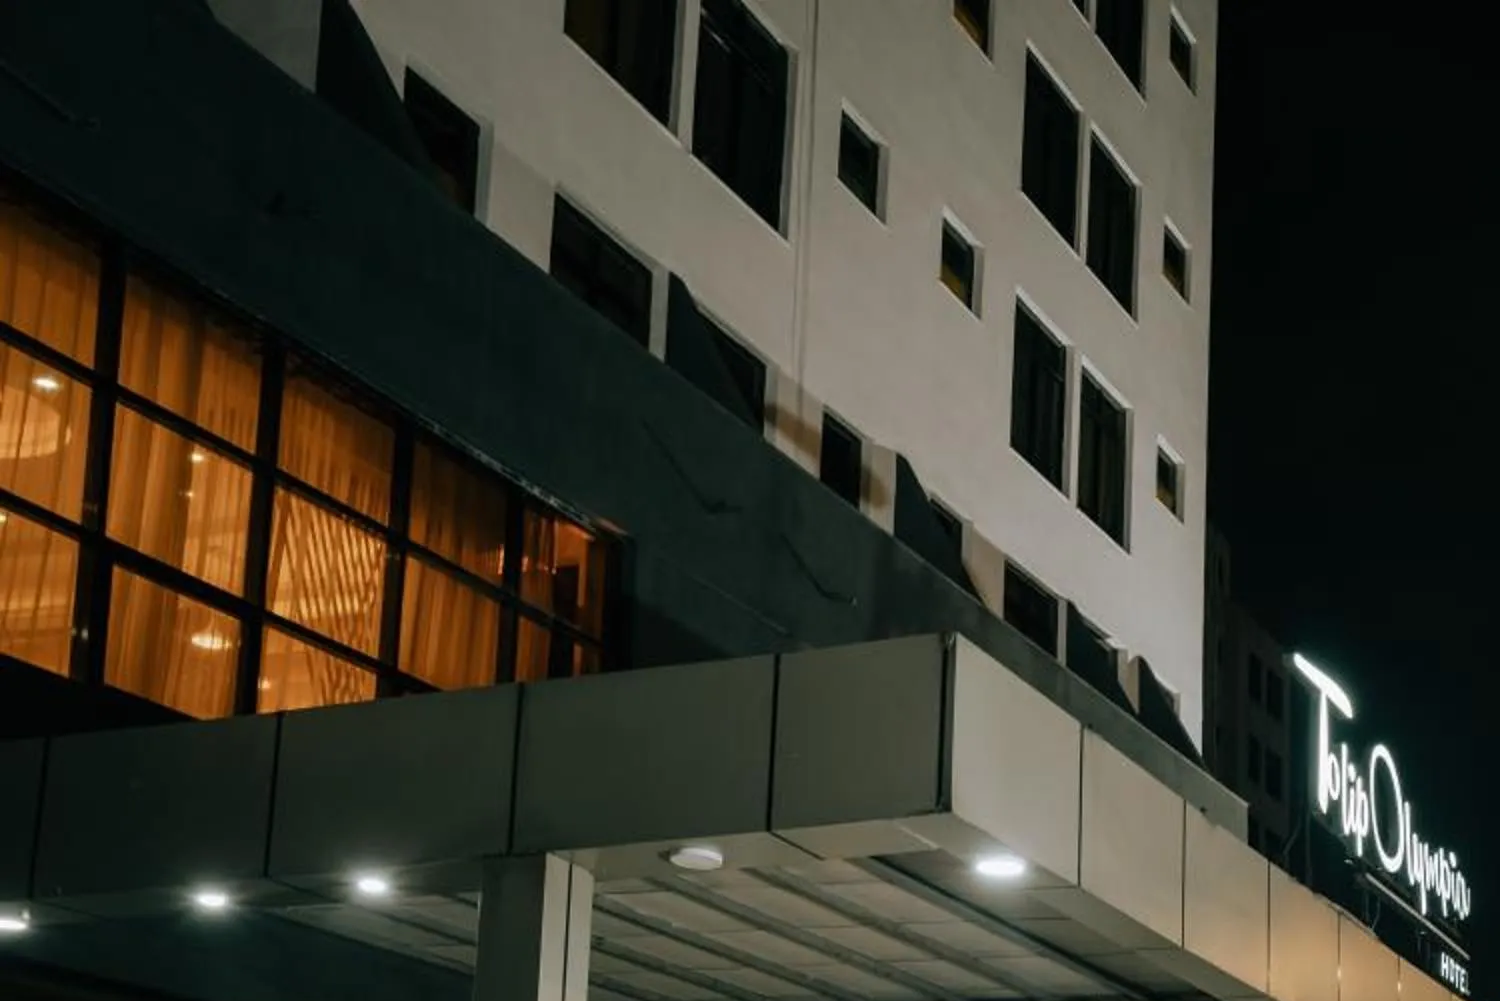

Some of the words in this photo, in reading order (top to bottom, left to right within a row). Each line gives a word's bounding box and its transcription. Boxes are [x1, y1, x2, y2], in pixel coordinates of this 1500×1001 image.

[1292, 651, 1370, 857] Tolip
[1369, 743, 1471, 921] Olympia
[1440, 951, 1472, 995] HOTEL
